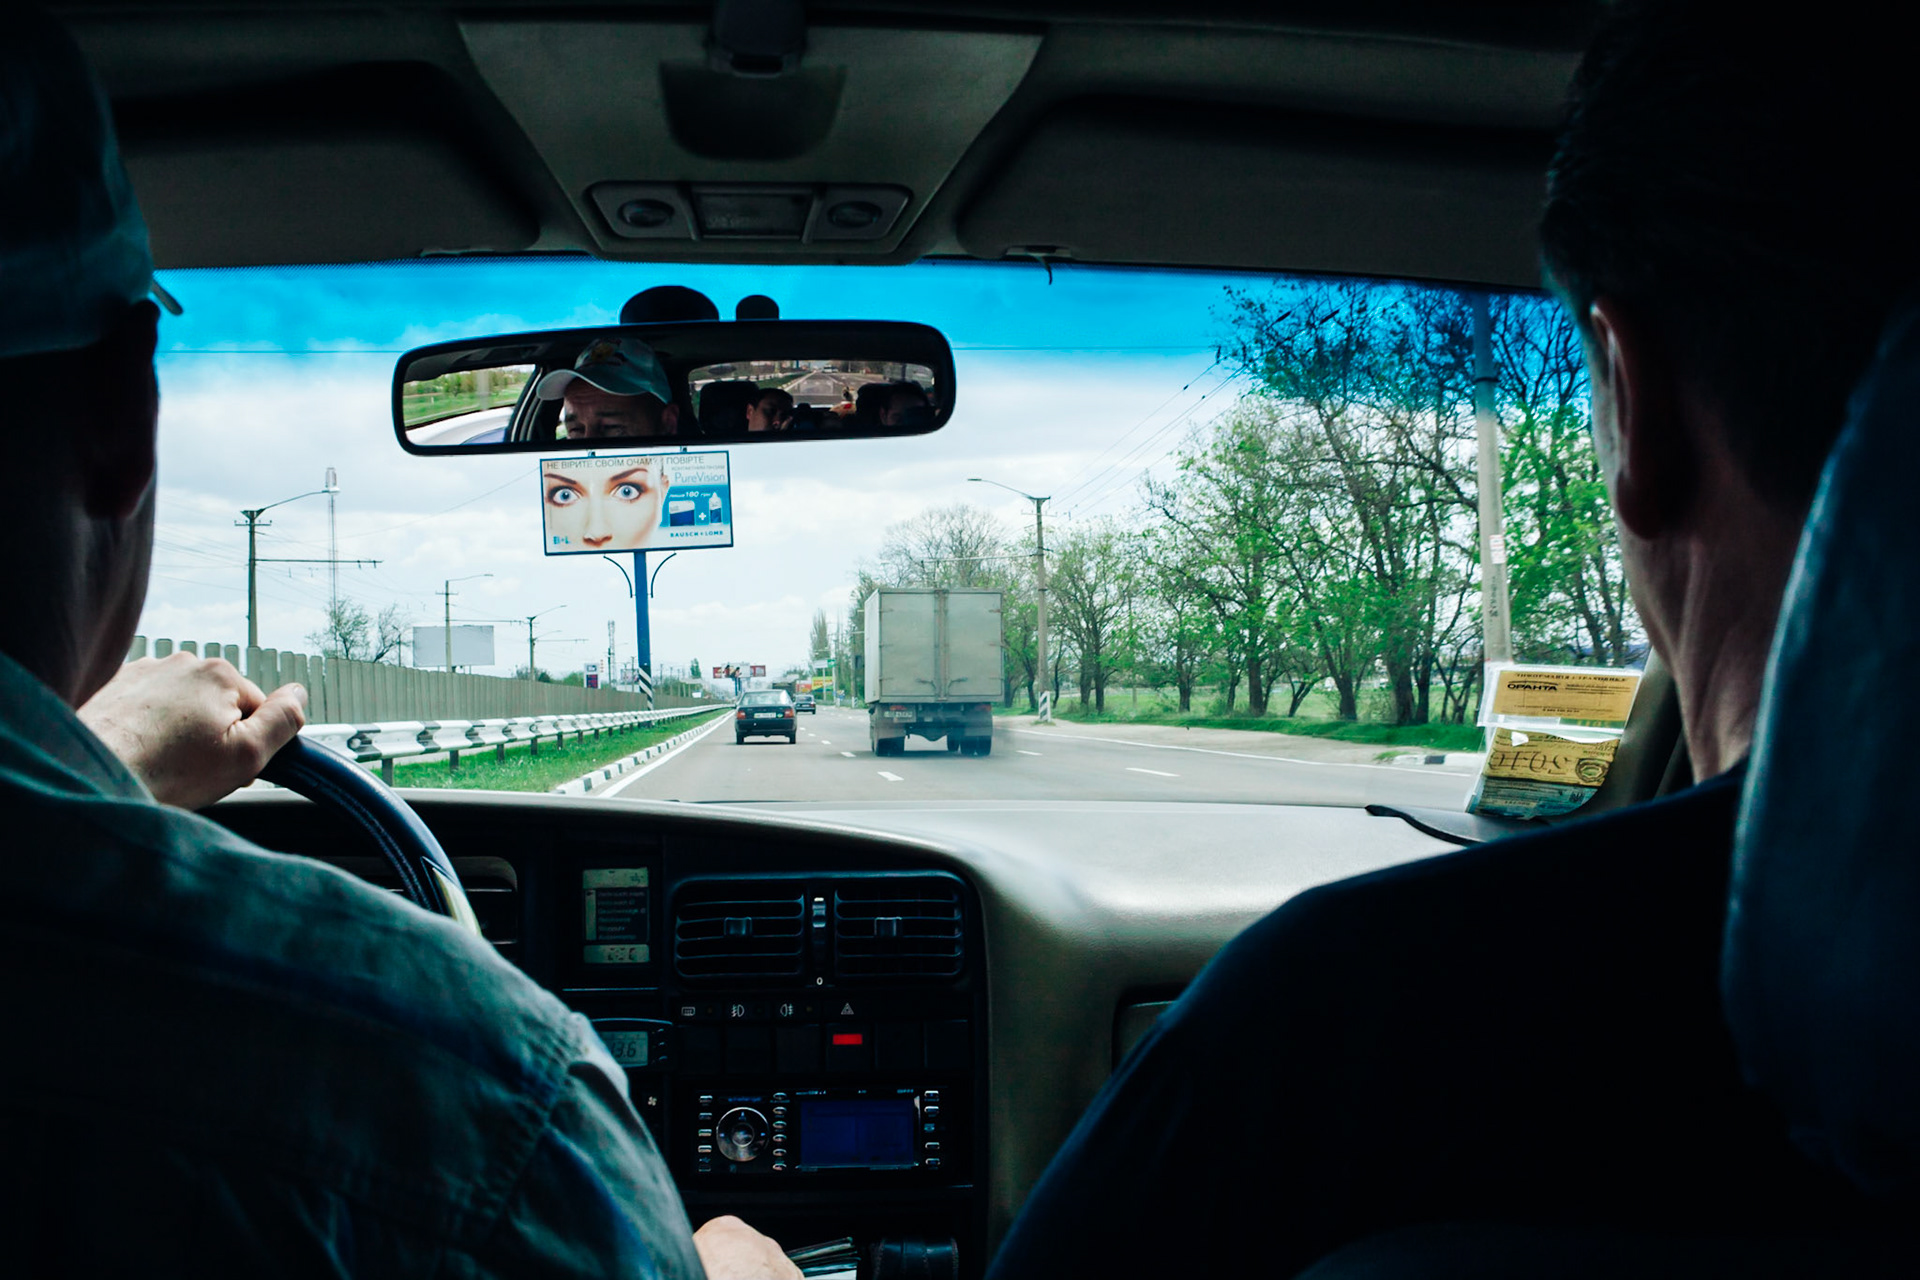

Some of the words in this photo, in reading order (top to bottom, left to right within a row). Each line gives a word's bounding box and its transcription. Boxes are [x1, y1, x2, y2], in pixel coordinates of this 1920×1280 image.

[546, 461, 559, 470] НЕ
[561, 460, 594, 469] ВІРИТЕ
[595, 458, 625, 468] СВОЇМ
[666, 456, 704, 465] ПОВІРТЕ
[674, 471, 725, 482] PureVision
[1507, 683, 1558, 692] ОРАНТА
